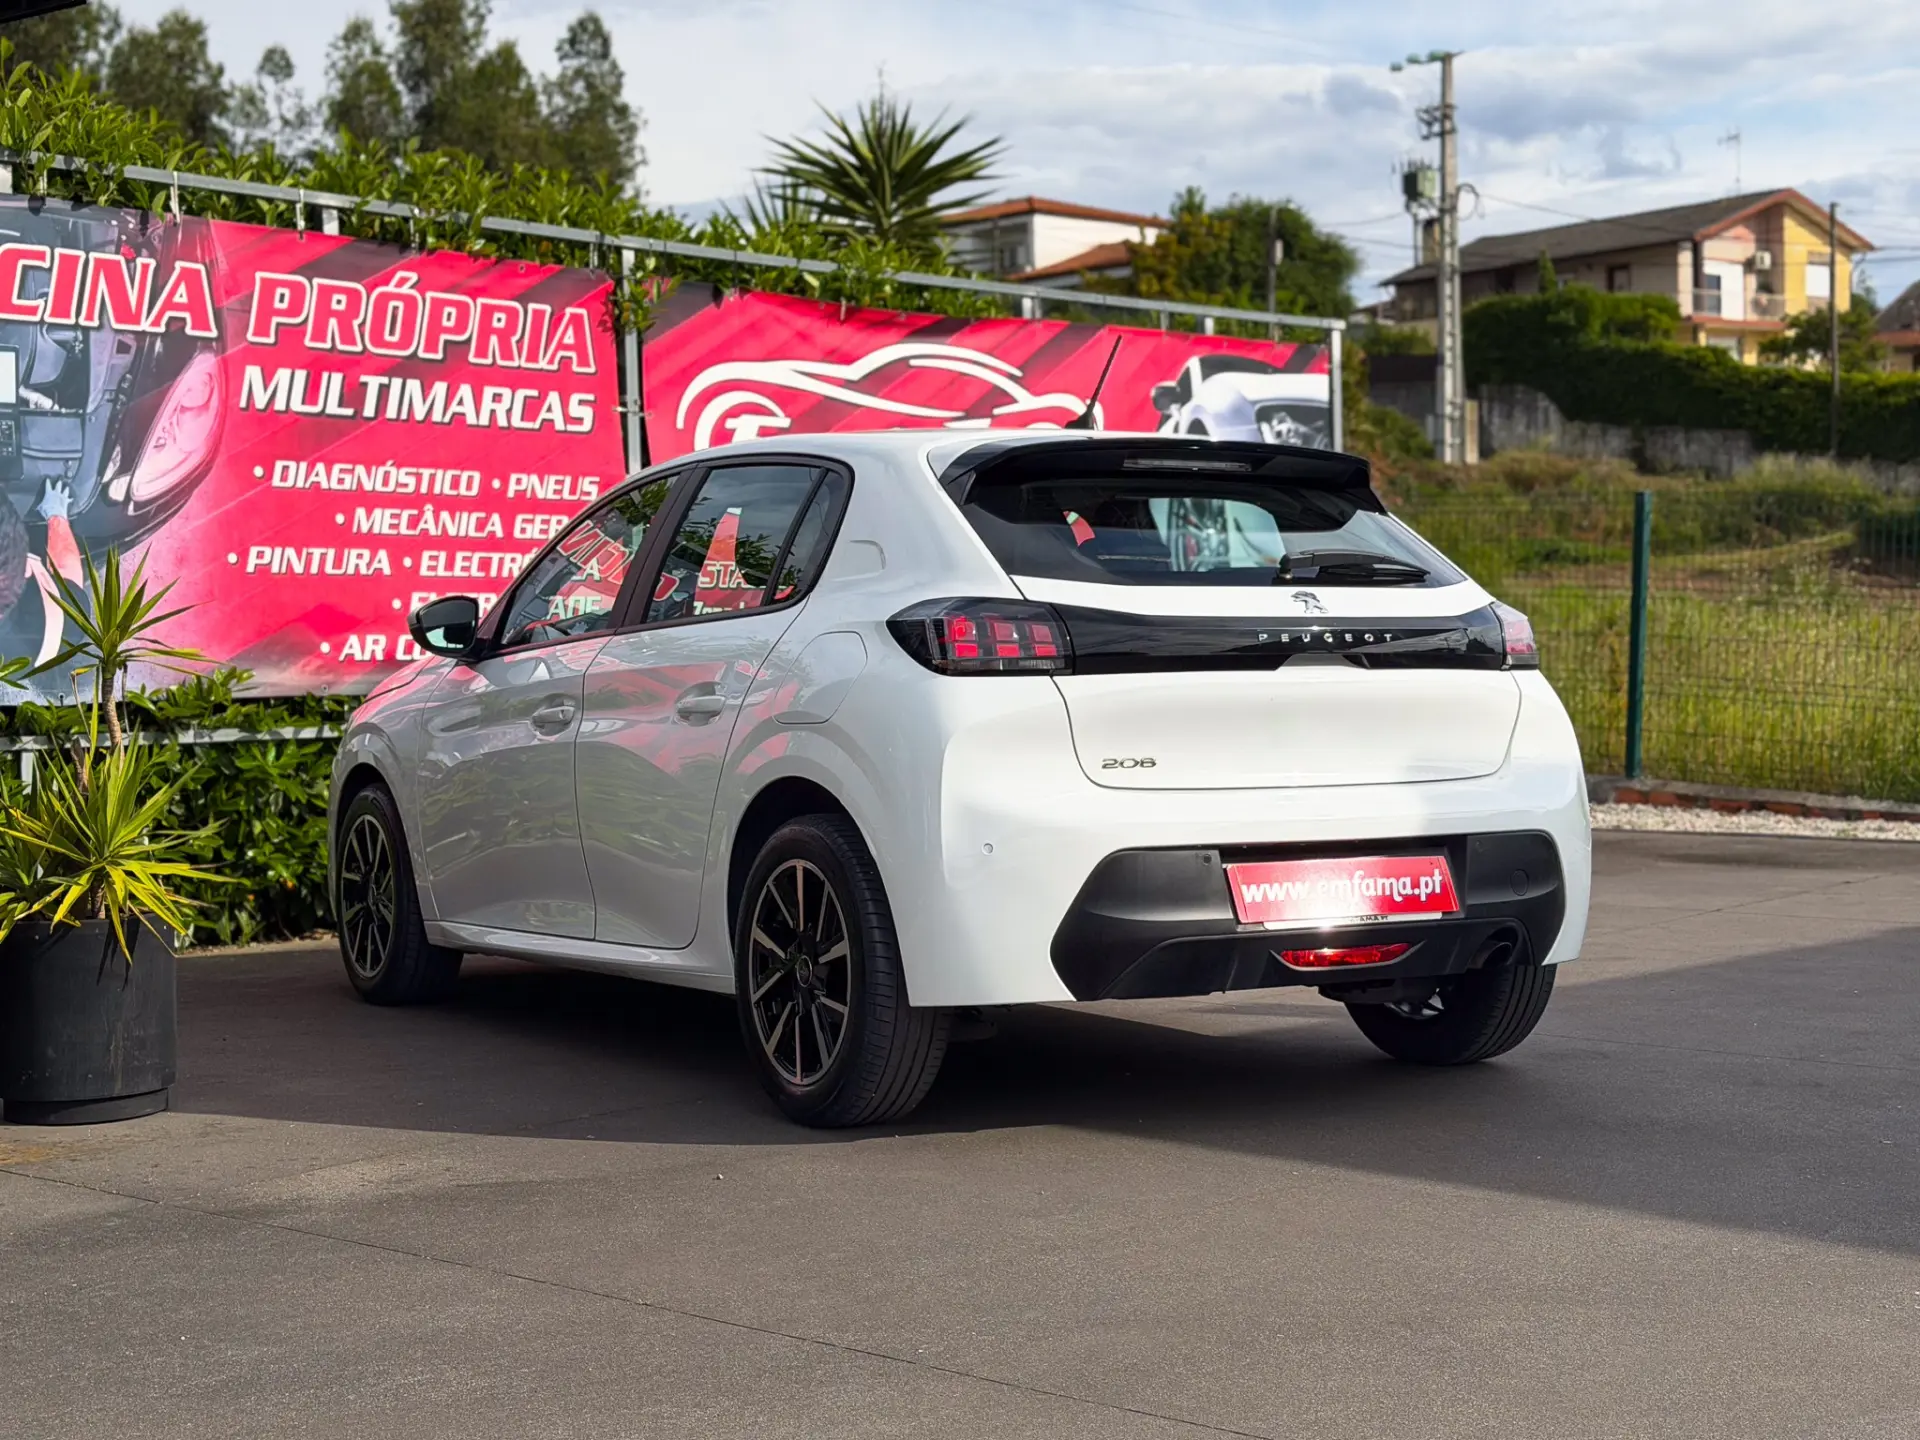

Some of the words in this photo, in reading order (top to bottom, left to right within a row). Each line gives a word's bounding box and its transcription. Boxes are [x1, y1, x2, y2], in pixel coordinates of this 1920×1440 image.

[247, 271, 596, 373] PRÓPRIA
[239, 365, 595, 433] MULTIMARCAS
[271, 460, 481, 497] DIAGNÓSTICO
[507, 473, 600, 501] PNEUS
[352, 504, 504, 538] MECÂNICA
[245, 546, 392, 576] PINTURA
[338, 634, 387, 661] AR
[1258, 633, 1393, 643] PEUGEOT
[1101, 757, 1157, 769] 208
